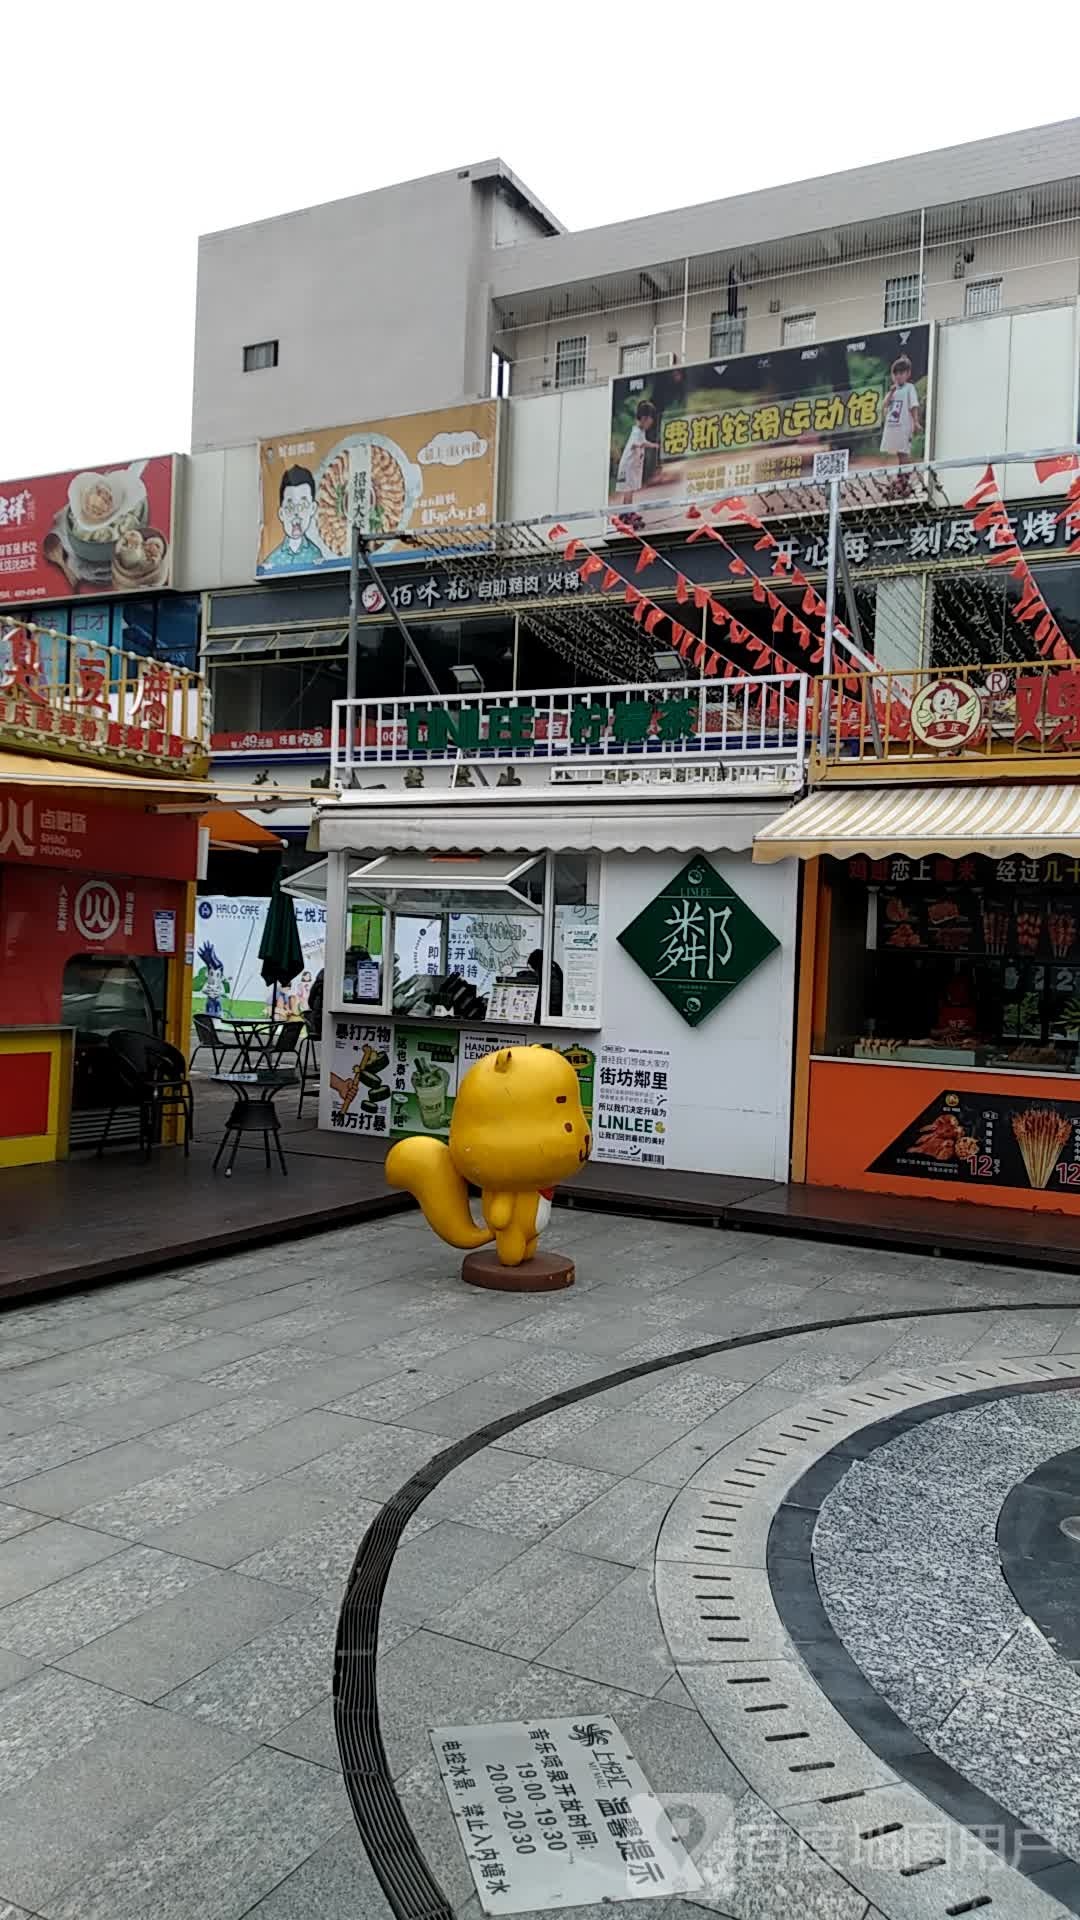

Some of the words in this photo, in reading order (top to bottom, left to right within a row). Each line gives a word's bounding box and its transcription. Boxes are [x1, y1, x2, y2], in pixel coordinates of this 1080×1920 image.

[662, 388, 881, 453] 费斯轮滑运动馆
[547, 571, 582, 594] 火锅
[0, 626, 170, 732] 臭豆腐
[216, 903, 237, 915] HALO
[239, 904, 260, 916] CAFE
[335, 1023, 391, 1043] 暴打万物
[598, 1114, 654, 1134] LINLEE
[966, 1154, 994, 1177] 12
[592, 1749, 633, 1790] 上悦汇
[486, 1763, 537, 1856] 20:00-20:30
[515, 1761, 568, 1852] 19:00-19:30
[597, 1796, 666, 1886] 温馨提示
